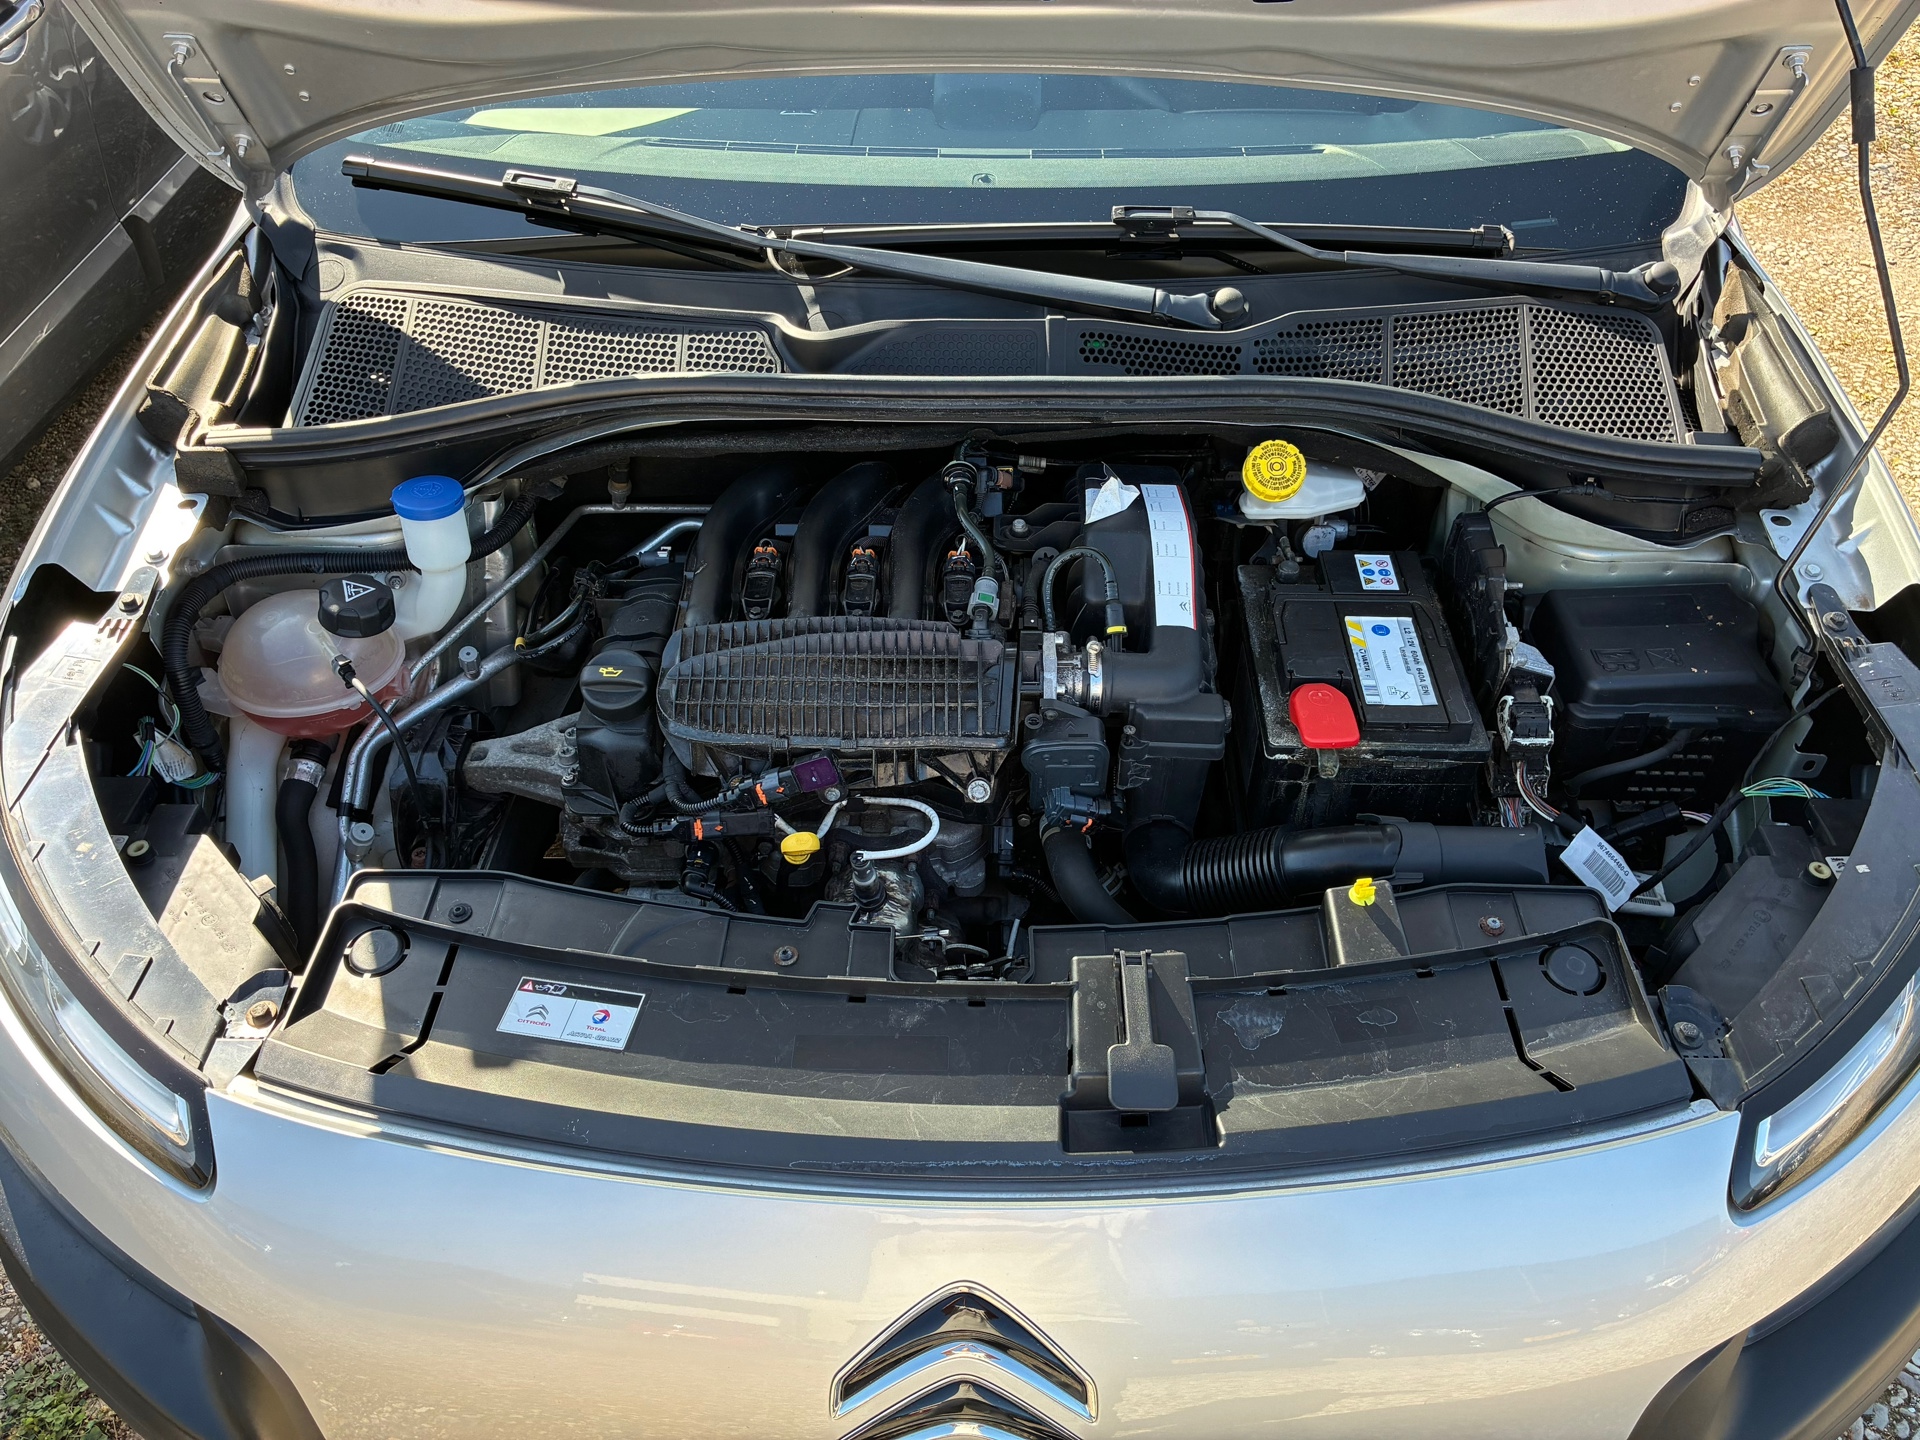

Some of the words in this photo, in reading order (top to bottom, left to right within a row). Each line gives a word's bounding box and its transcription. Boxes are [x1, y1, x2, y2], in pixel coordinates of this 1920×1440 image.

[1406, 636, 1416, 648] 12V
[1361, 654, 1371, 671] VARTA
[1410, 650, 1420, 666] 60Ah
[1416, 667, 1426, 683] 640A
